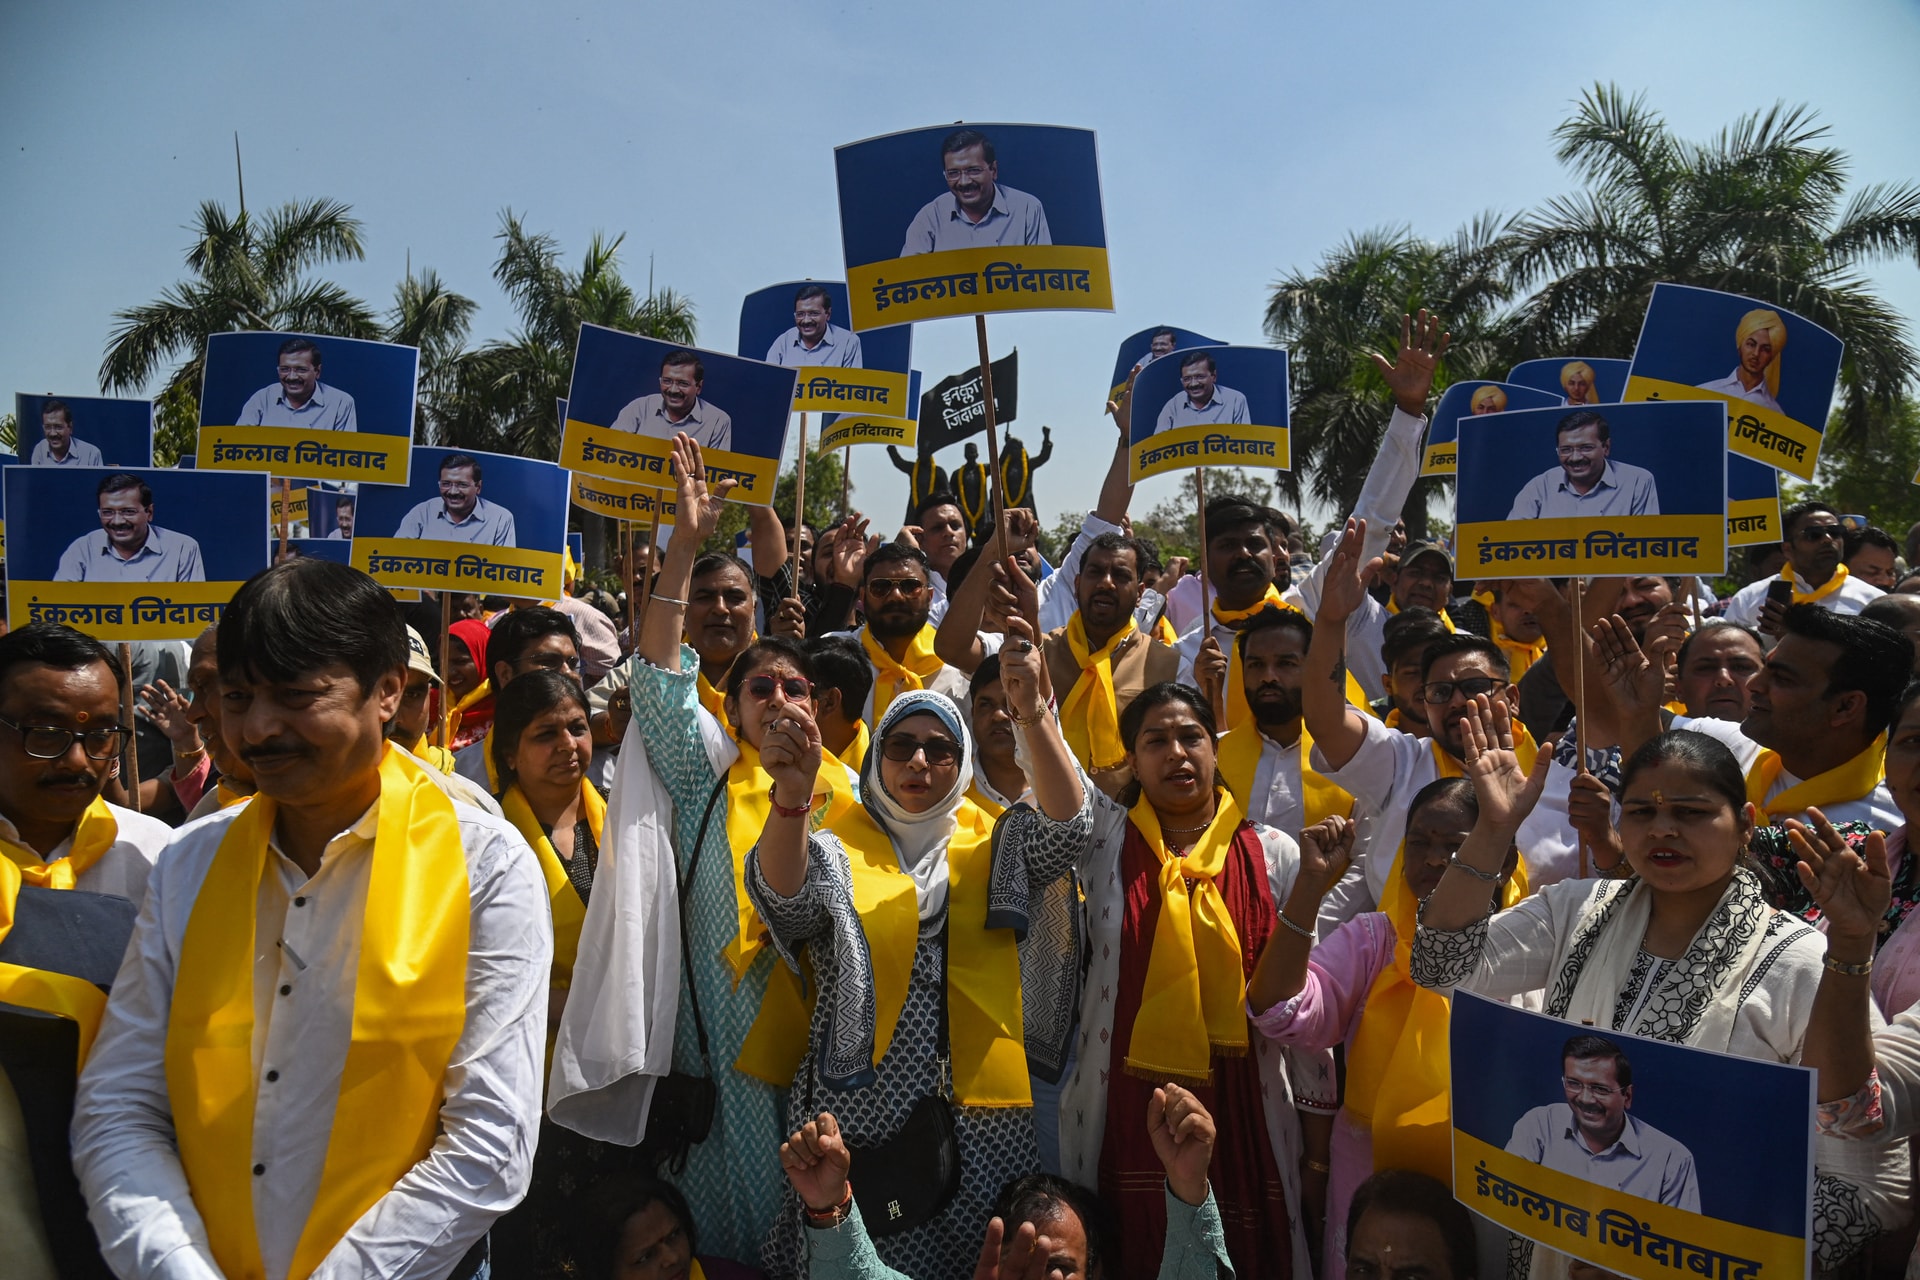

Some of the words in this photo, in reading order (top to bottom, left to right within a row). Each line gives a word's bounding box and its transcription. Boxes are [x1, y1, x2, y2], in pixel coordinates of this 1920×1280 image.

[873, 278, 978, 312] इंकलाब
[982, 262, 1090, 294] जिंदाबाद
[808, 377, 890, 404] जिंदाबाद
[852, 422, 905, 439] जिंदाबाद
[1734, 414, 1807, 463] जिंदाबाद
[213, 438, 291, 464] इंकलाब
[293, 440, 388, 470] जिंदाबाद
[582, 437, 665, 474] इंकलाब
[1139, 440, 1200, 470] इंकलाब
[1203, 434, 1276, 457] जिंदाबाद
[1429, 452, 1457, 467] इंकल
[577, 482, 627, 511] इंकलाब
[1478, 536, 1578, 564] इंकलाब
[1583, 530, 1699, 559] जिंदाबाद
[368, 549, 450, 577] इंकलाब
[455, 554, 545, 586] जिंदाबाद
[27, 596, 125, 624] इंकलाब
[129, 596, 228, 624] जिंदाबा
[1474, 1160, 1590, 1237] इंकलाब
[1596, 1208, 1763, 1280] जिंदाबाद
